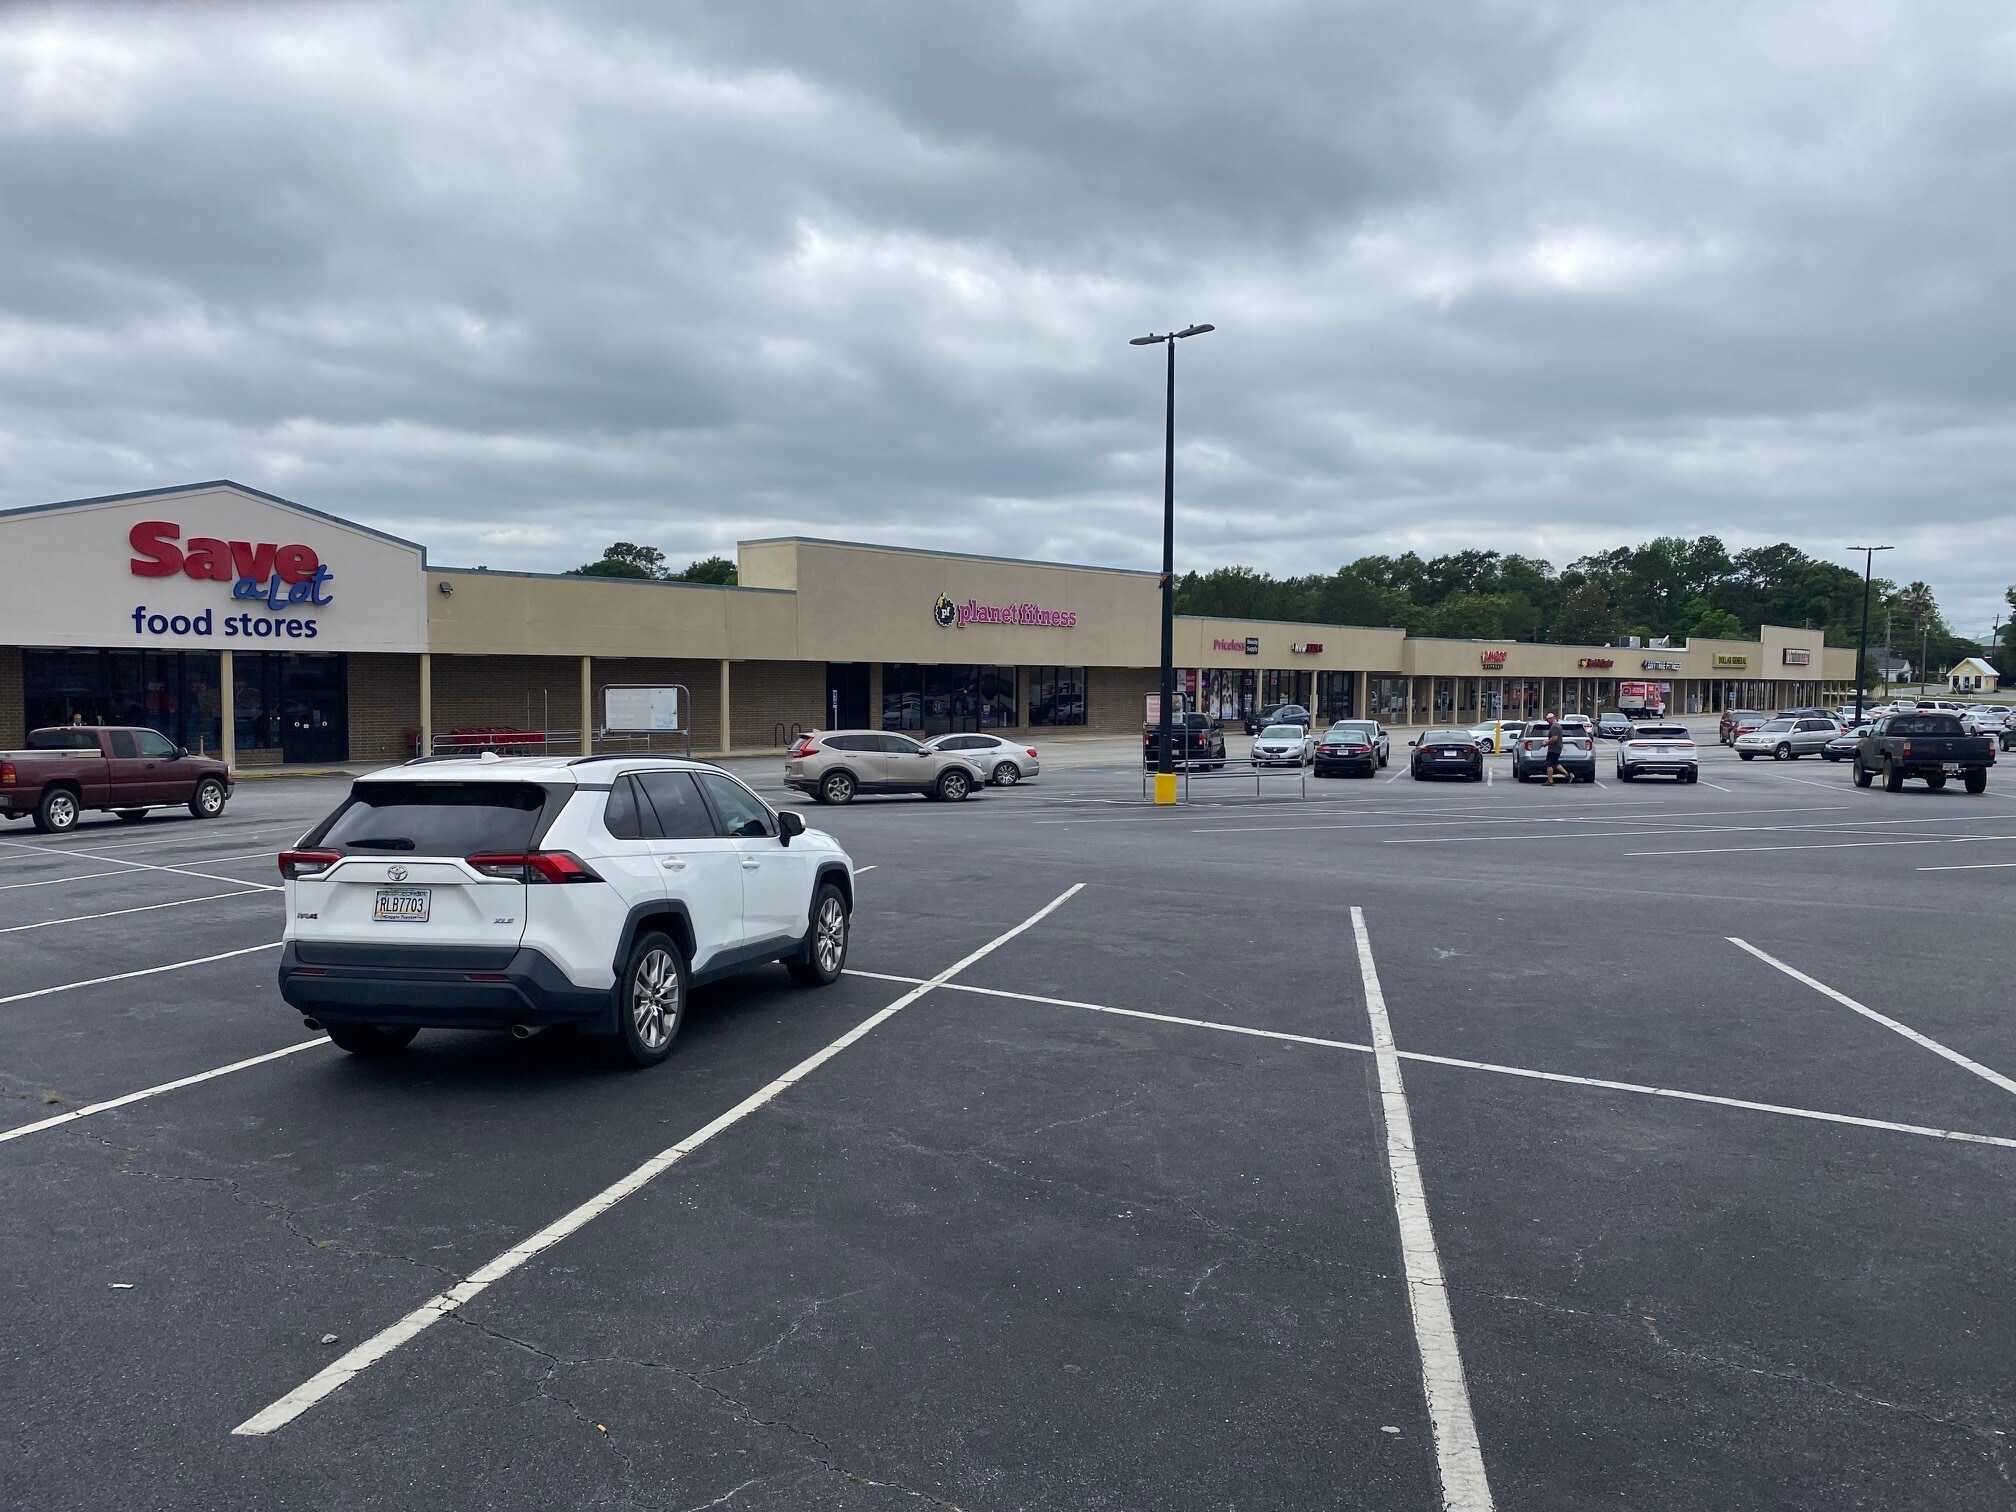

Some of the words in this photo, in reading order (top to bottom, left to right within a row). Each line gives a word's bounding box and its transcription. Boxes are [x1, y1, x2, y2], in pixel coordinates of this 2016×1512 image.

[129, 521, 319, 584] Save
[132, 606, 212, 635] food
[224, 613, 318, 638] stores
[957, 599, 1018, 628] planet
[1019, 602, 1077, 627] fitness
[1213, 639, 1245, 651] Priceless
[1718, 656, 1732, 664] DOLLAR
[1732, 656, 1747, 665] GENERAL
[380, 897, 424, 912] RLB7703
